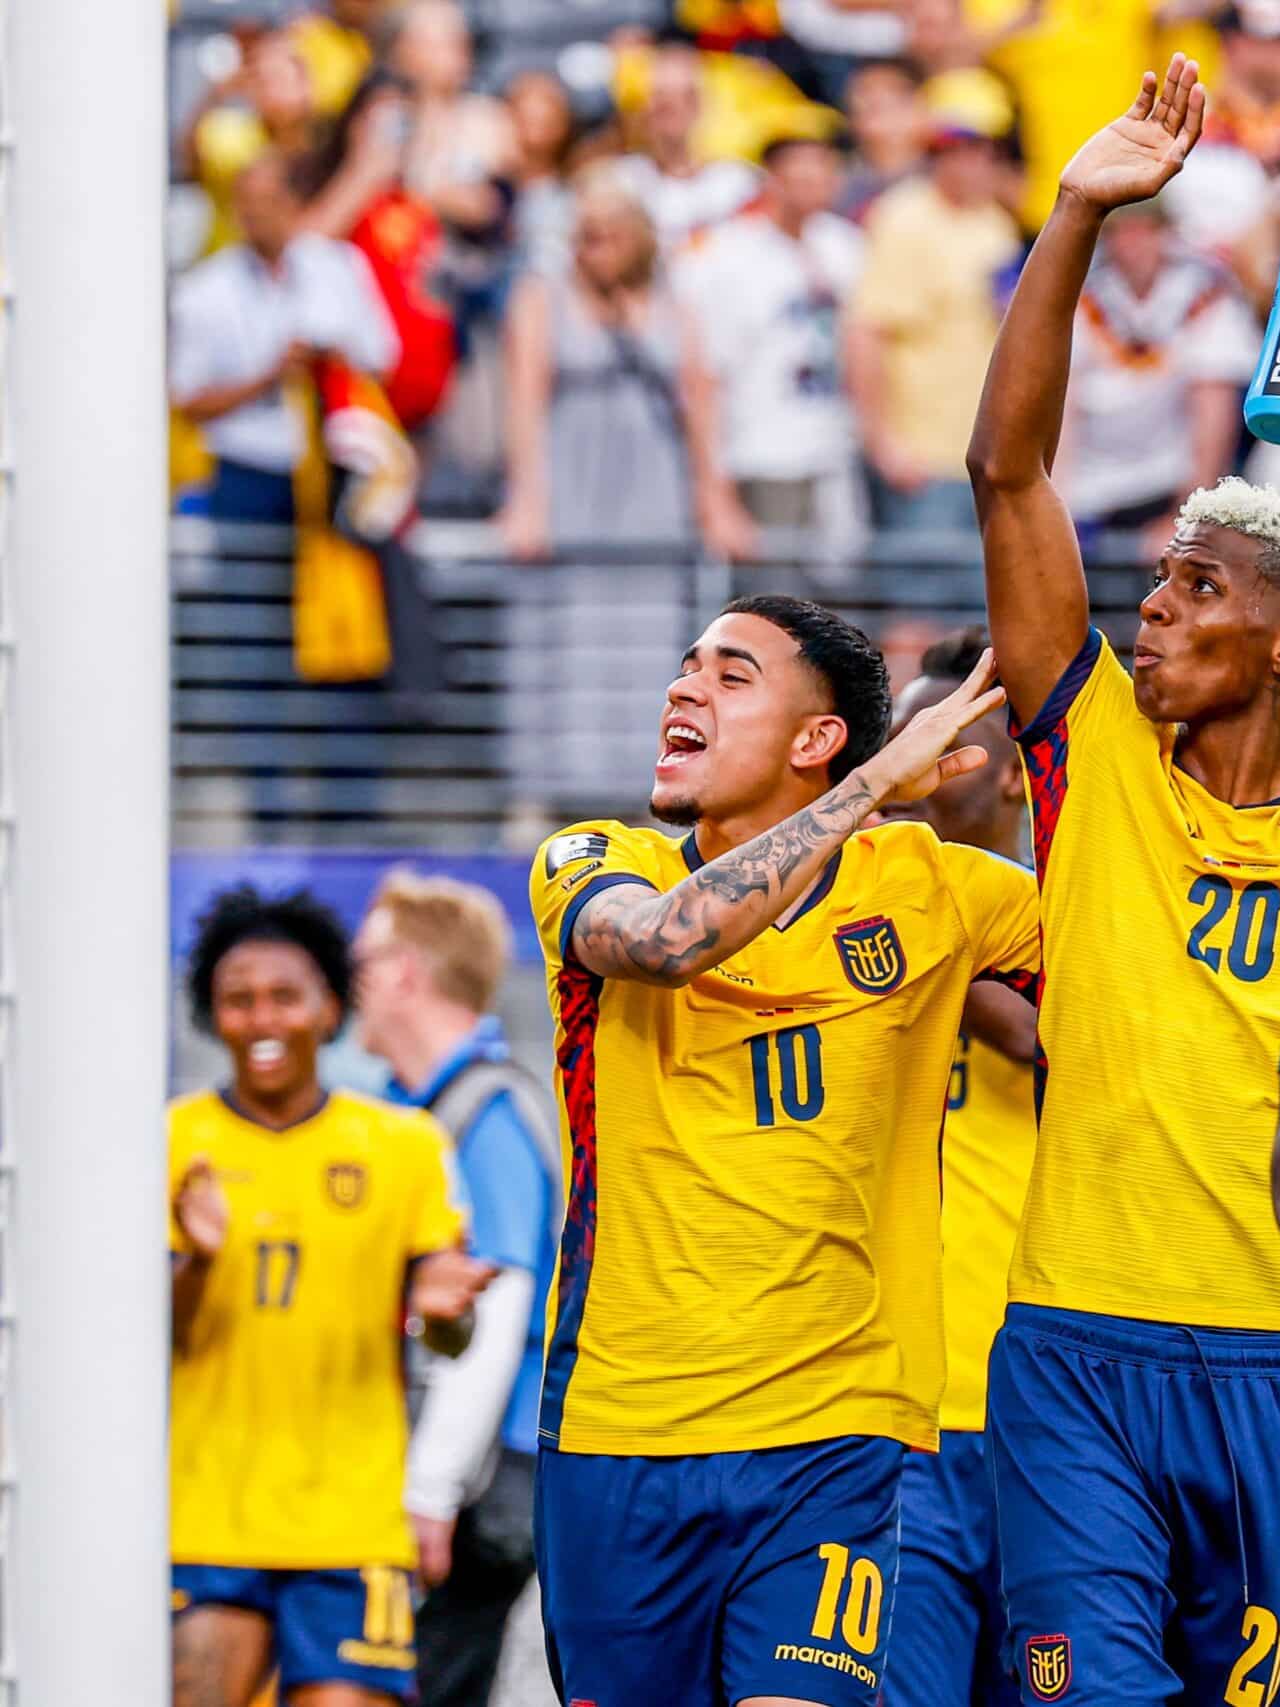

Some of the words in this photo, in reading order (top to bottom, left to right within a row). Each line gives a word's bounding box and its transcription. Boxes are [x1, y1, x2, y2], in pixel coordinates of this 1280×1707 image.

[742, 1022, 825, 1127] 10
[256, 1239, 299, 1313] 17
[811, 1542, 883, 1656] 10
[774, 1643, 878, 1689] marathon
